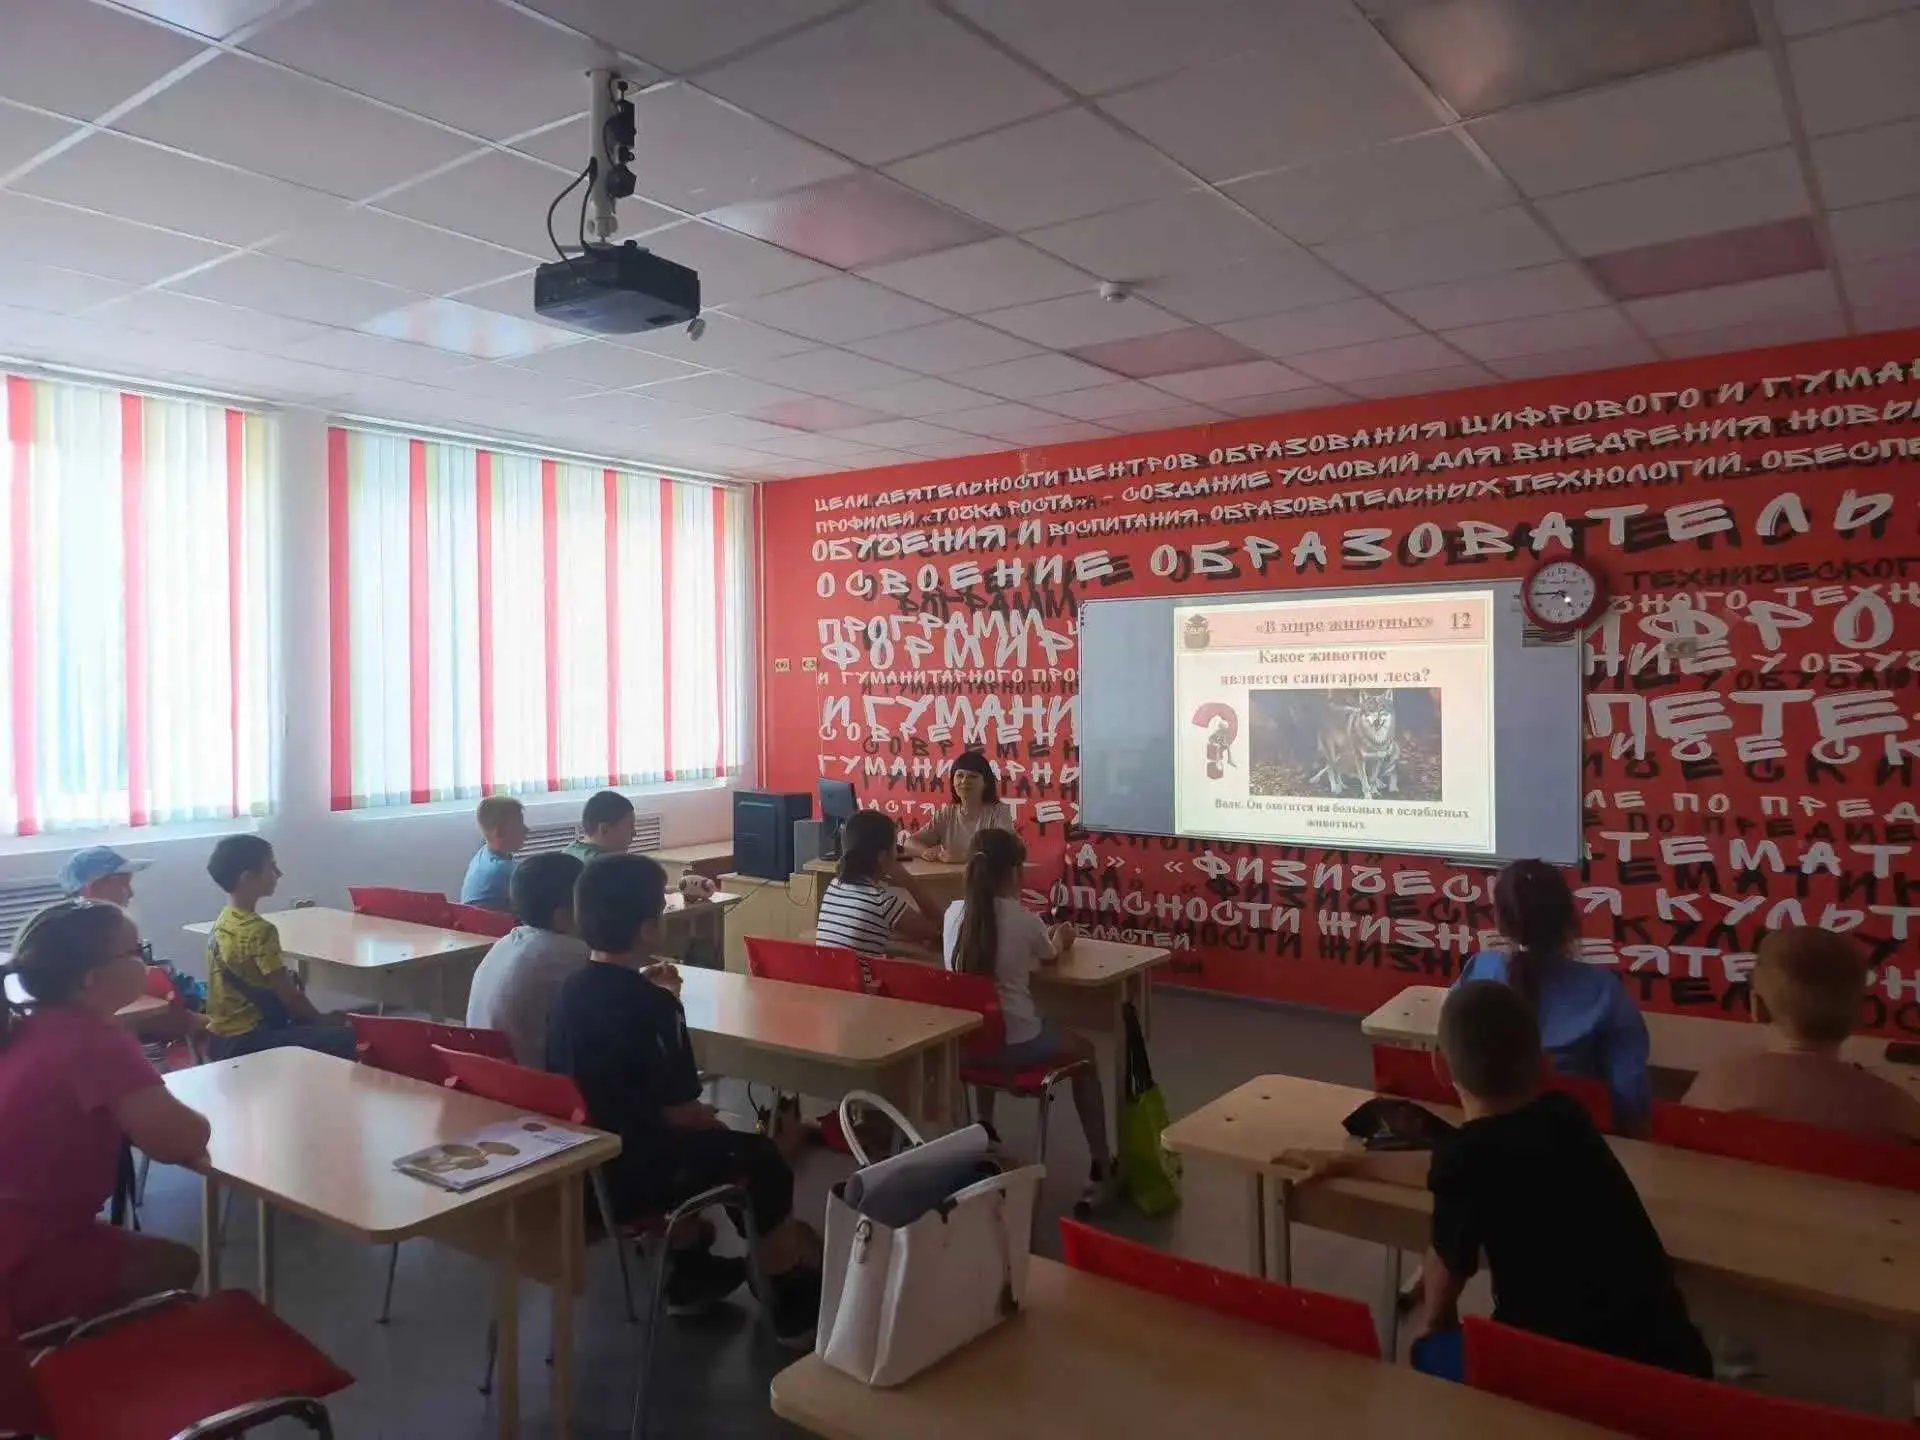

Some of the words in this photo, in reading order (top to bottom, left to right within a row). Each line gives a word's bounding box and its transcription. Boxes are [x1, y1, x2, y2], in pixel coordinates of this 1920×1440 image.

[815, 494, 869, 512] ЦЕЛИ
[875, 469, 1059, 507] ДЕЯТЕЛЬНОСТИ
[1067, 453, 1200, 484] ЦЕНТРОВ
[1209, 421, 1448, 465] ОБРАЗОВАНИЯ
[1461, 387, 1700, 434] ЦИФРОВОГО
[1717, 381, 1744, 404] И
[815, 509, 915, 534] ПРОФИЛЕЙ
[1122, 470, 1271, 503] СОЗДАНИЕ
[1277, 451, 1419, 485] УСЛОВИЙ
[1428, 445, 1501, 471] ДЛЯ
[1512, 415, 1771, 461] ВНЕДРЕНИЯ
[812, 524, 1006, 561] ОБУЧЕНИЯ
[1018, 518, 1042, 546] И
[1210, 476, 1502, 521] ОБРАЗОВАТЕЛЬНЫХ
[816, 550, 1114, 598] ОСВОЕНИЕ
[818, 608, 1045, 644] ПРОГРАММ
[1281, 621, 1325, 637] мире
[1450, 611, 1473, 630] 12
[1258, 649, 1305, 664] Какое
[1309, 649, 1387, 663] животное
[841, 669, 1024, 685] ГУМАНИТАРНОГО
[1031, 668, 1079, 683] ПРО
[1220, 674, 1289, 686] является
[1293, 671, 1379, 686] санитаром
[1383, 667, 1431, 684] леса?
[819, 722, 1079, 747] СОВРЕМЕН
